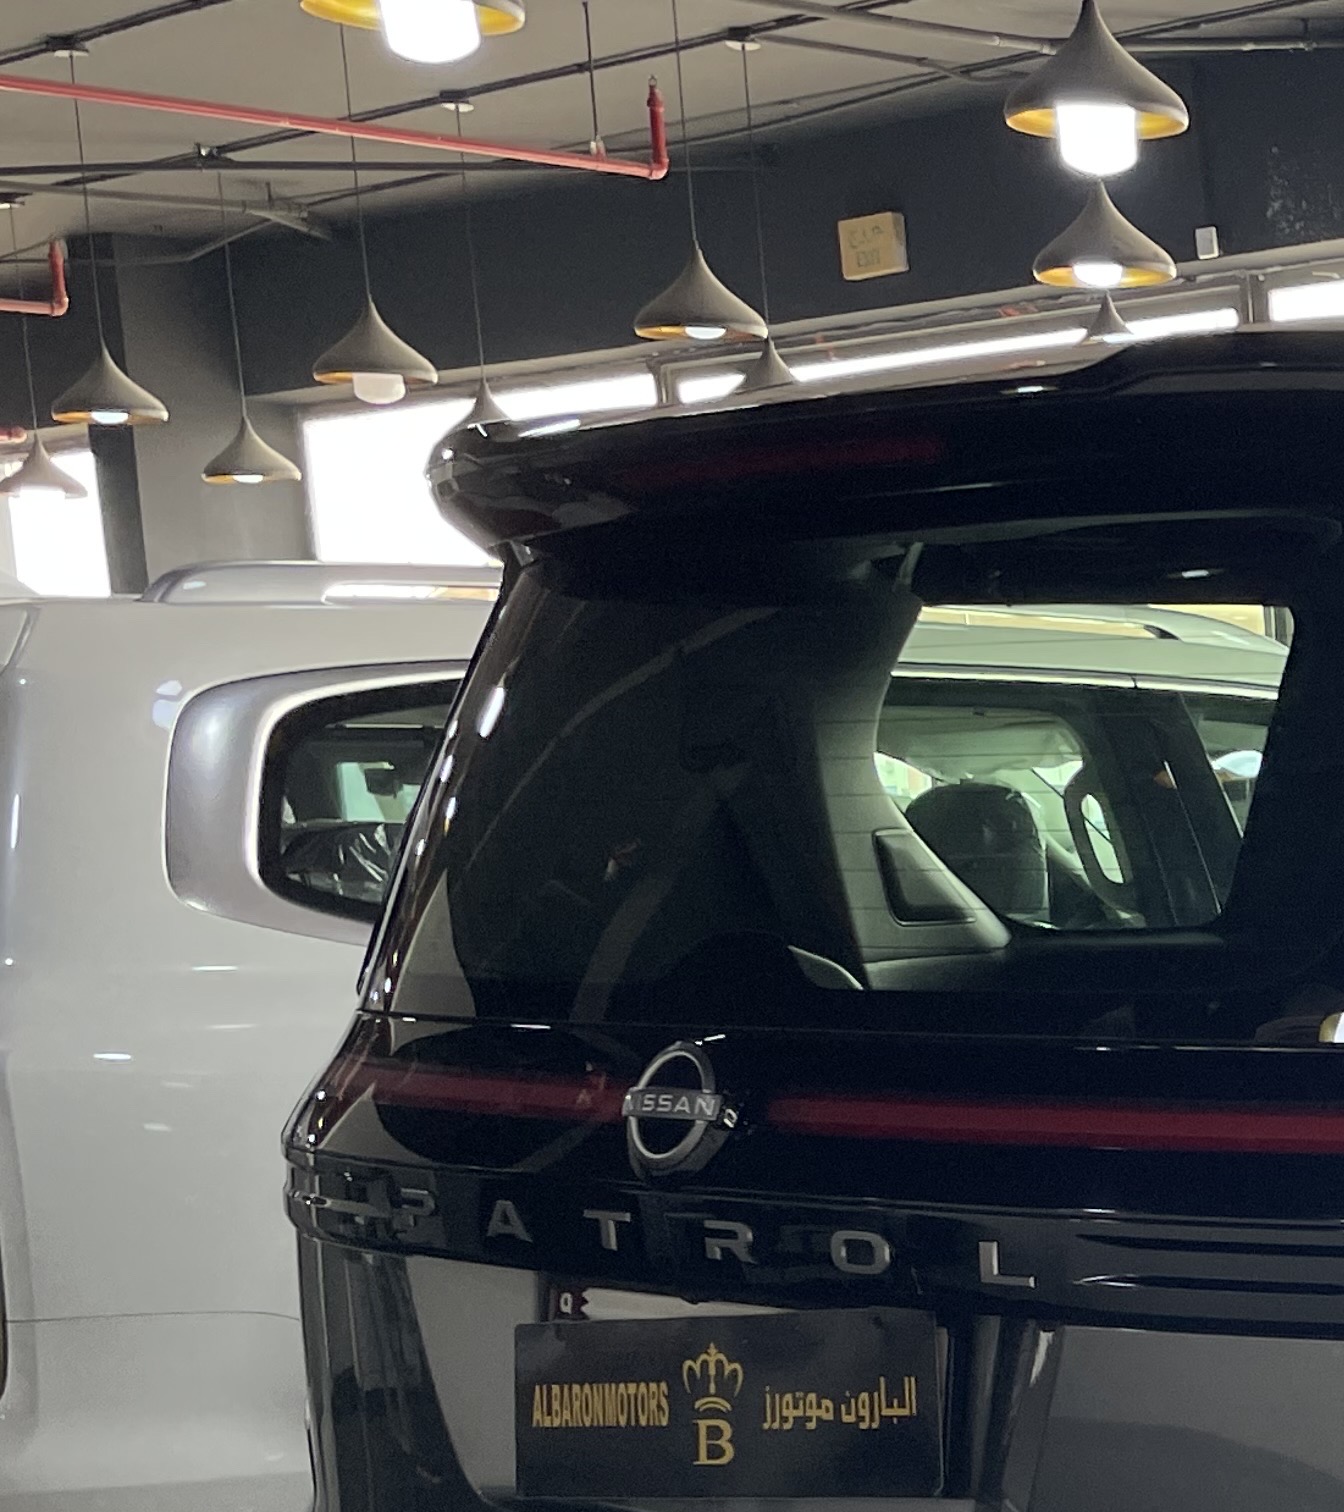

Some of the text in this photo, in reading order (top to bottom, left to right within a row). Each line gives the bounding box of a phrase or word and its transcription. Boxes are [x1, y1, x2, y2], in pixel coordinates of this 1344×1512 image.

[625, 1094, 717, 1117] NISSAN
[395, 1188, 1037, 1288] PATROL
[761, 1376, 918, 1431] البارون موتورز
[692, 1418, 736, 1467] B
